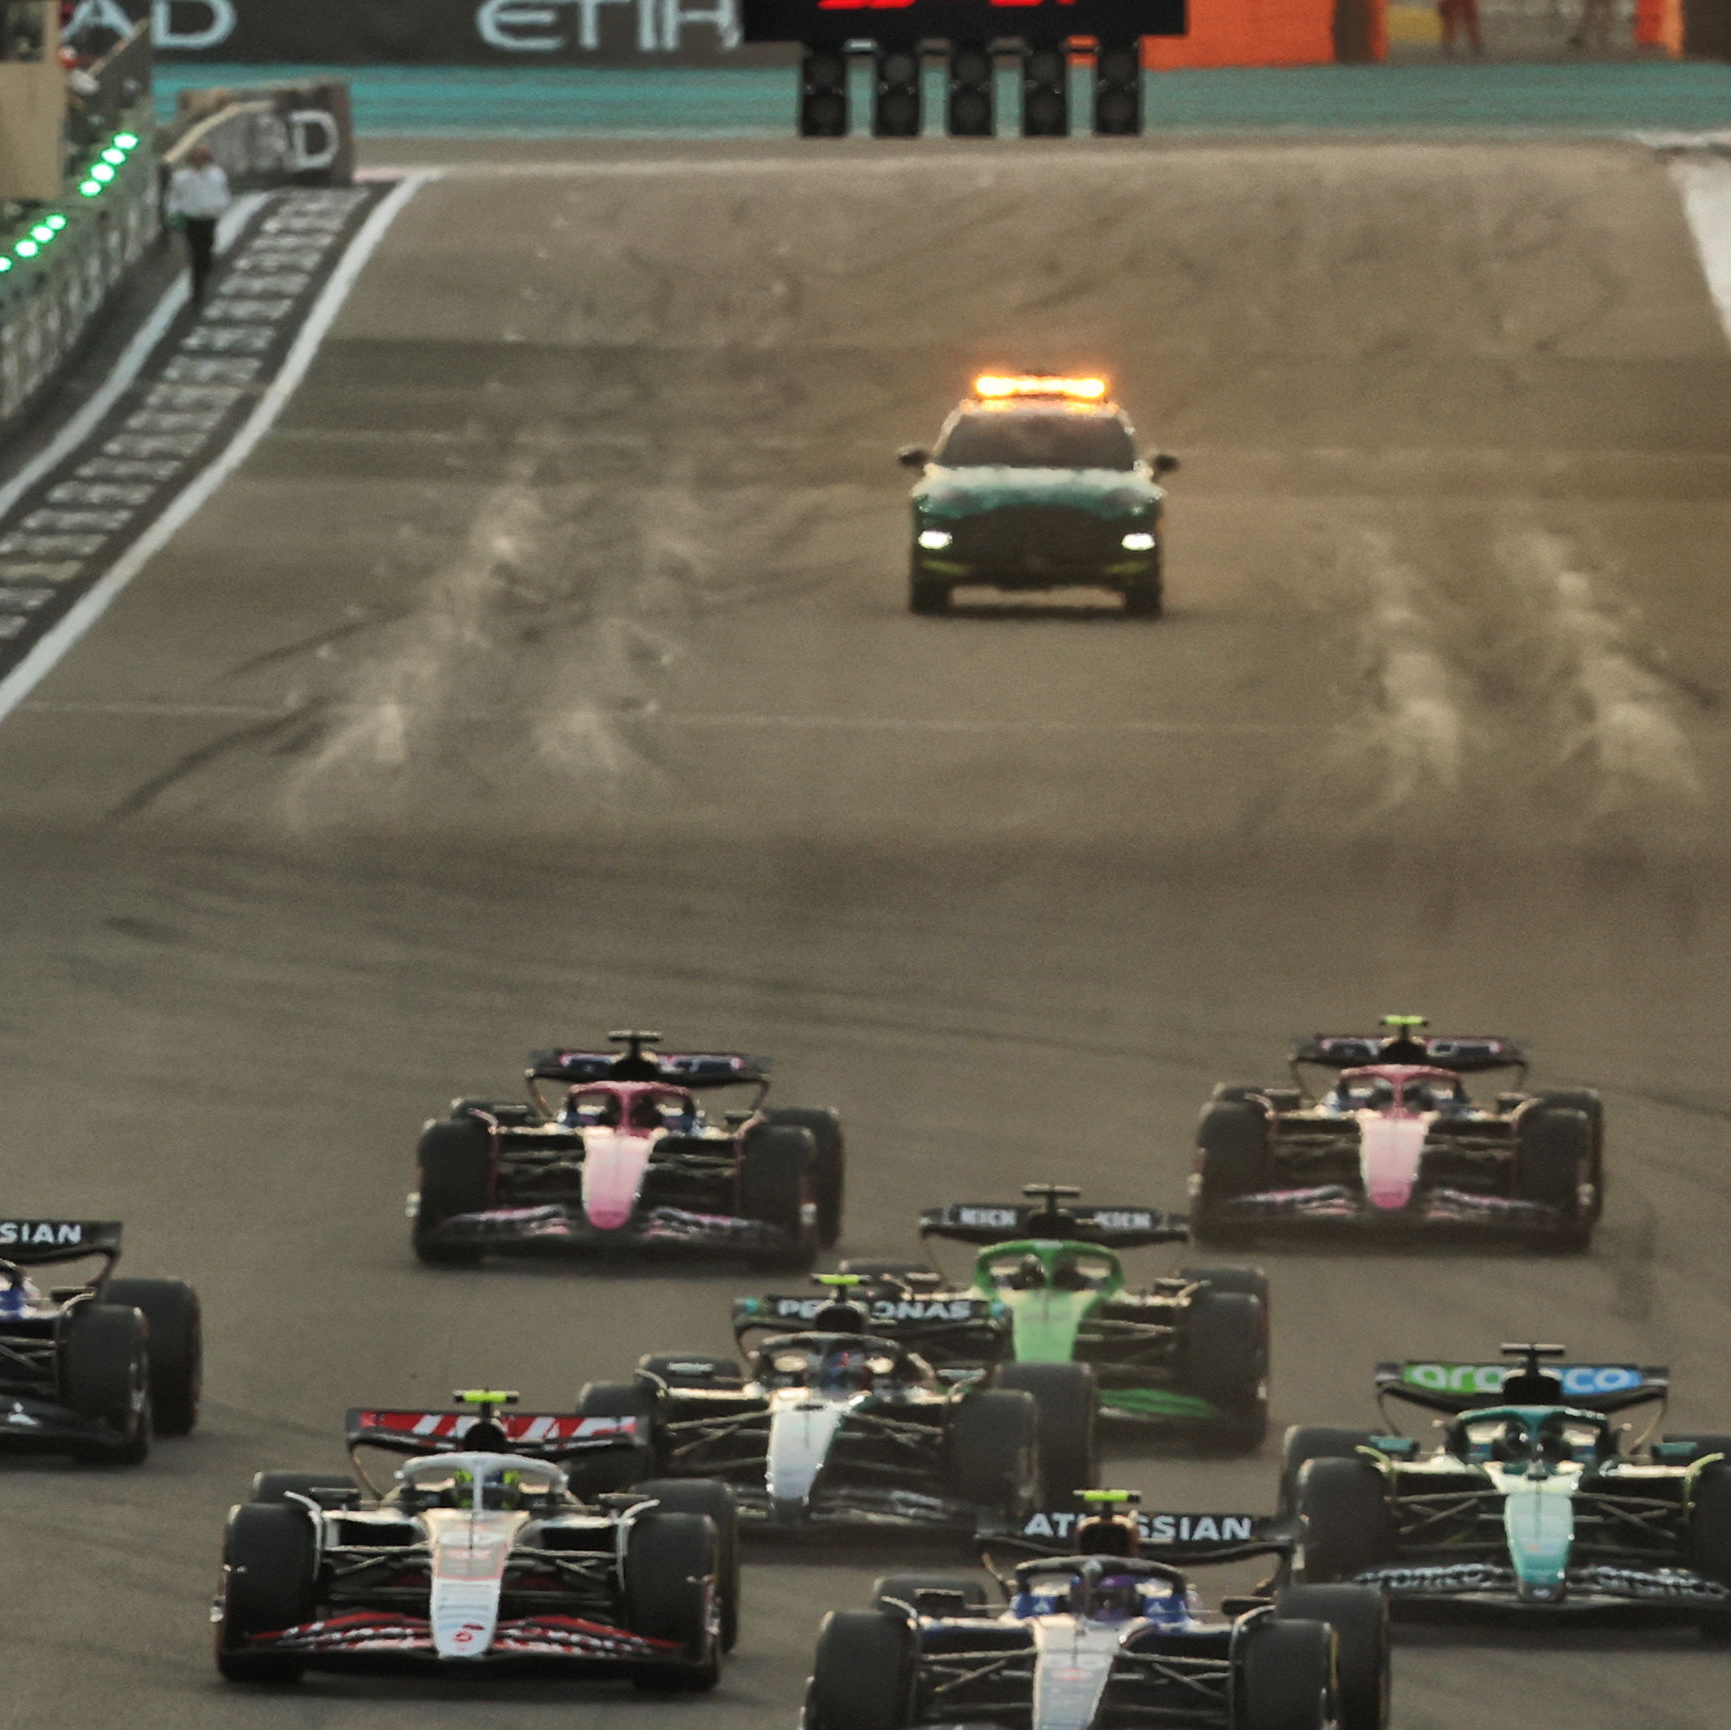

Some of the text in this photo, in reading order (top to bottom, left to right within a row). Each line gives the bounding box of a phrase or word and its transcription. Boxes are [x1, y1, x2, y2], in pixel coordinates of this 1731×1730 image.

[476, 0, 741, 50] ETIH
[776, 1299, 973, 1321] PEONAS
[1407, 1365, 1631, 1393] araco
[1024, 1512, 1253, 1542] ATSSIAN
